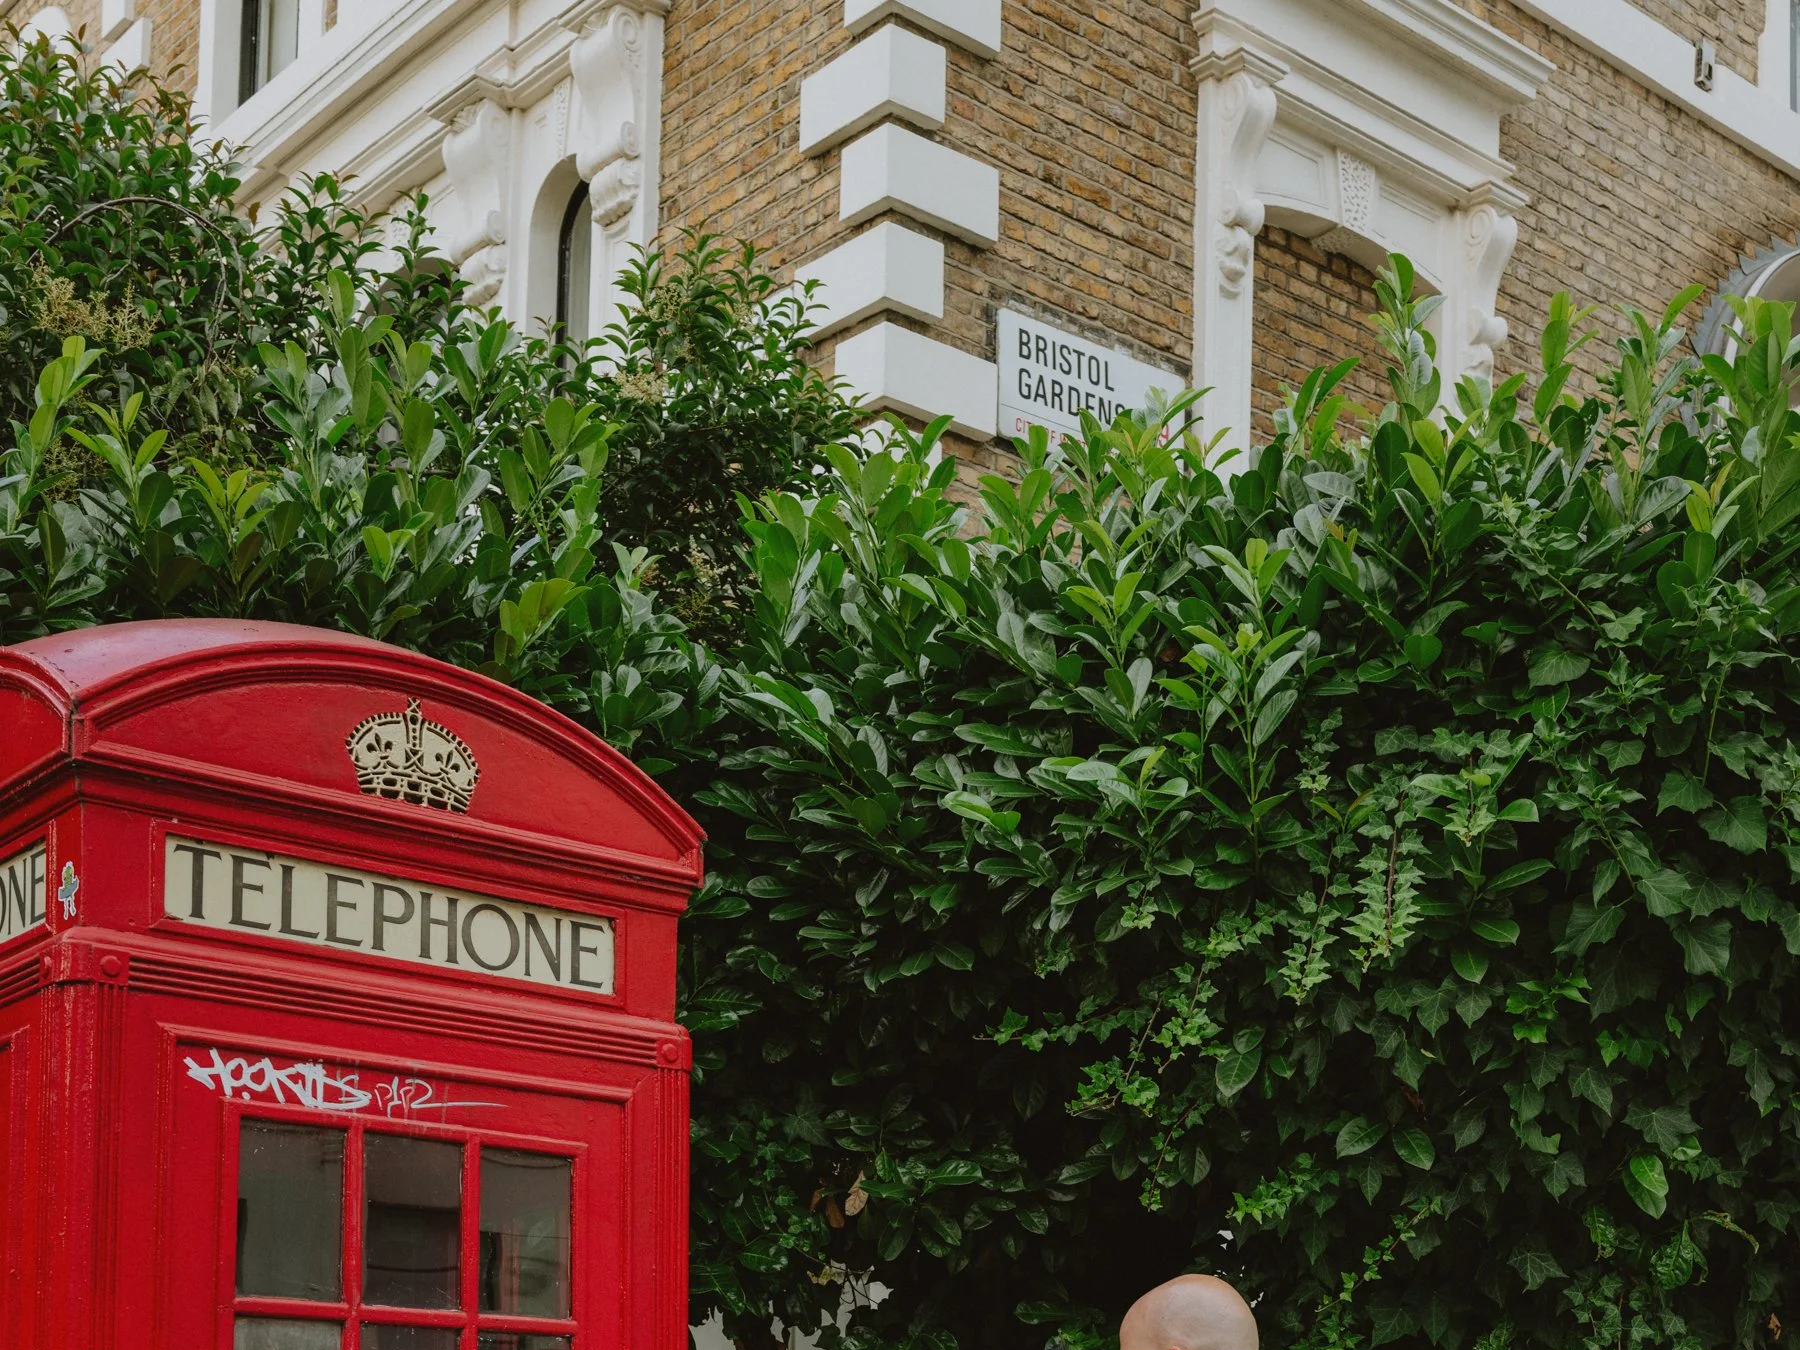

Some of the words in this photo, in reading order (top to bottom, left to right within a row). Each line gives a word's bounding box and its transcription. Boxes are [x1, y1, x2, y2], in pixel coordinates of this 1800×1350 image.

[1018, 327, 1115, 392] BRISTOL
[0, 847, 46, 936] NE
[173, 843, 605, 989] TELEPHONE
